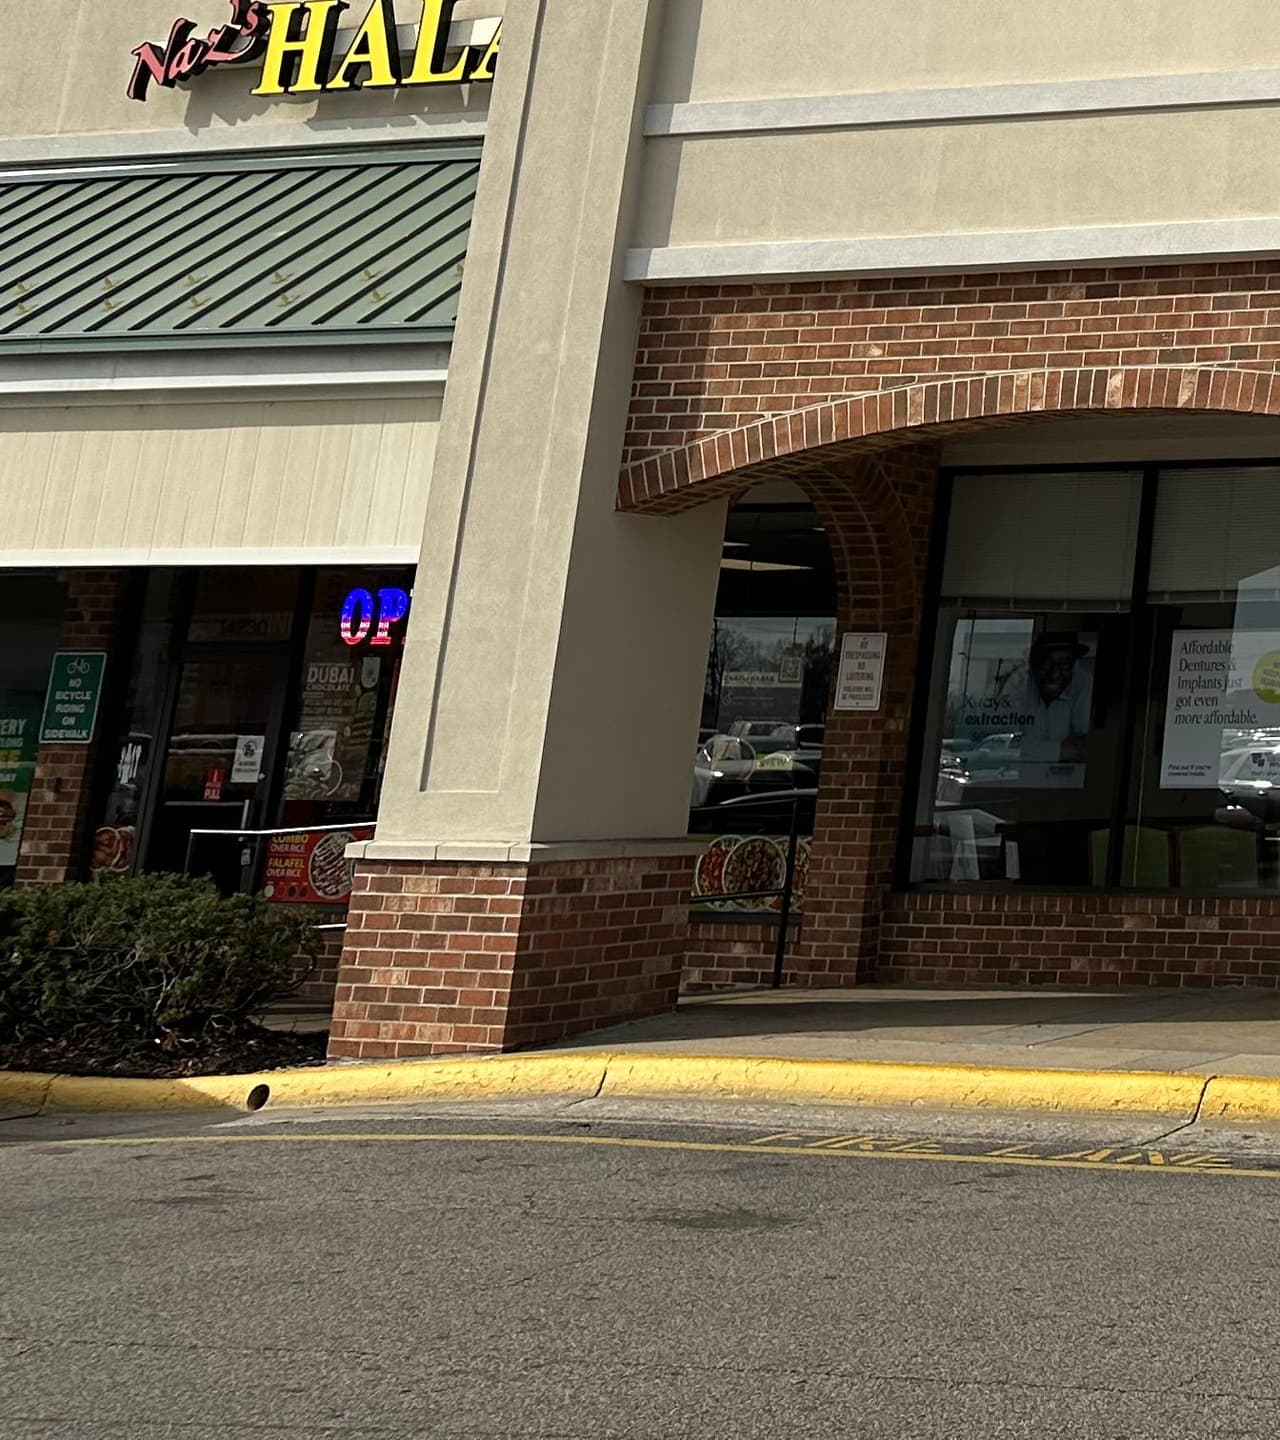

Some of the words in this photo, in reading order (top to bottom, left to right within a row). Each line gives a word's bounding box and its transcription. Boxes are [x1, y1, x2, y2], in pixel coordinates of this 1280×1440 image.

[340, 588, 413, 646] OP
[1179, 658, 1226, 672] Dentures
[307, 666, 355, 683] DUBAI
[67, 678, 82, 688] NO
[1177, 676, 1222, 693] Implants
[54, 691, 93, 700] BICYCLE
[54, 704, 86, 713] RIDING
[1174, 695, 1192, 711] got
[1194, 697, 1218, 707] even
[61, 716, 76, 725] ON
[965, 712, 1035, 726] extraction
[1174, 714, 1201, 725] more
[1203, 710, 1258, 725] affordable.
[0, 719, 27, 736] ERY
[44, 729, 88, 739] SIDEWALK
[267, 858, 305, 868] FALAFEL
[266, 868, 285, 877] OVER
[286, 868, 302, 877] RICE
